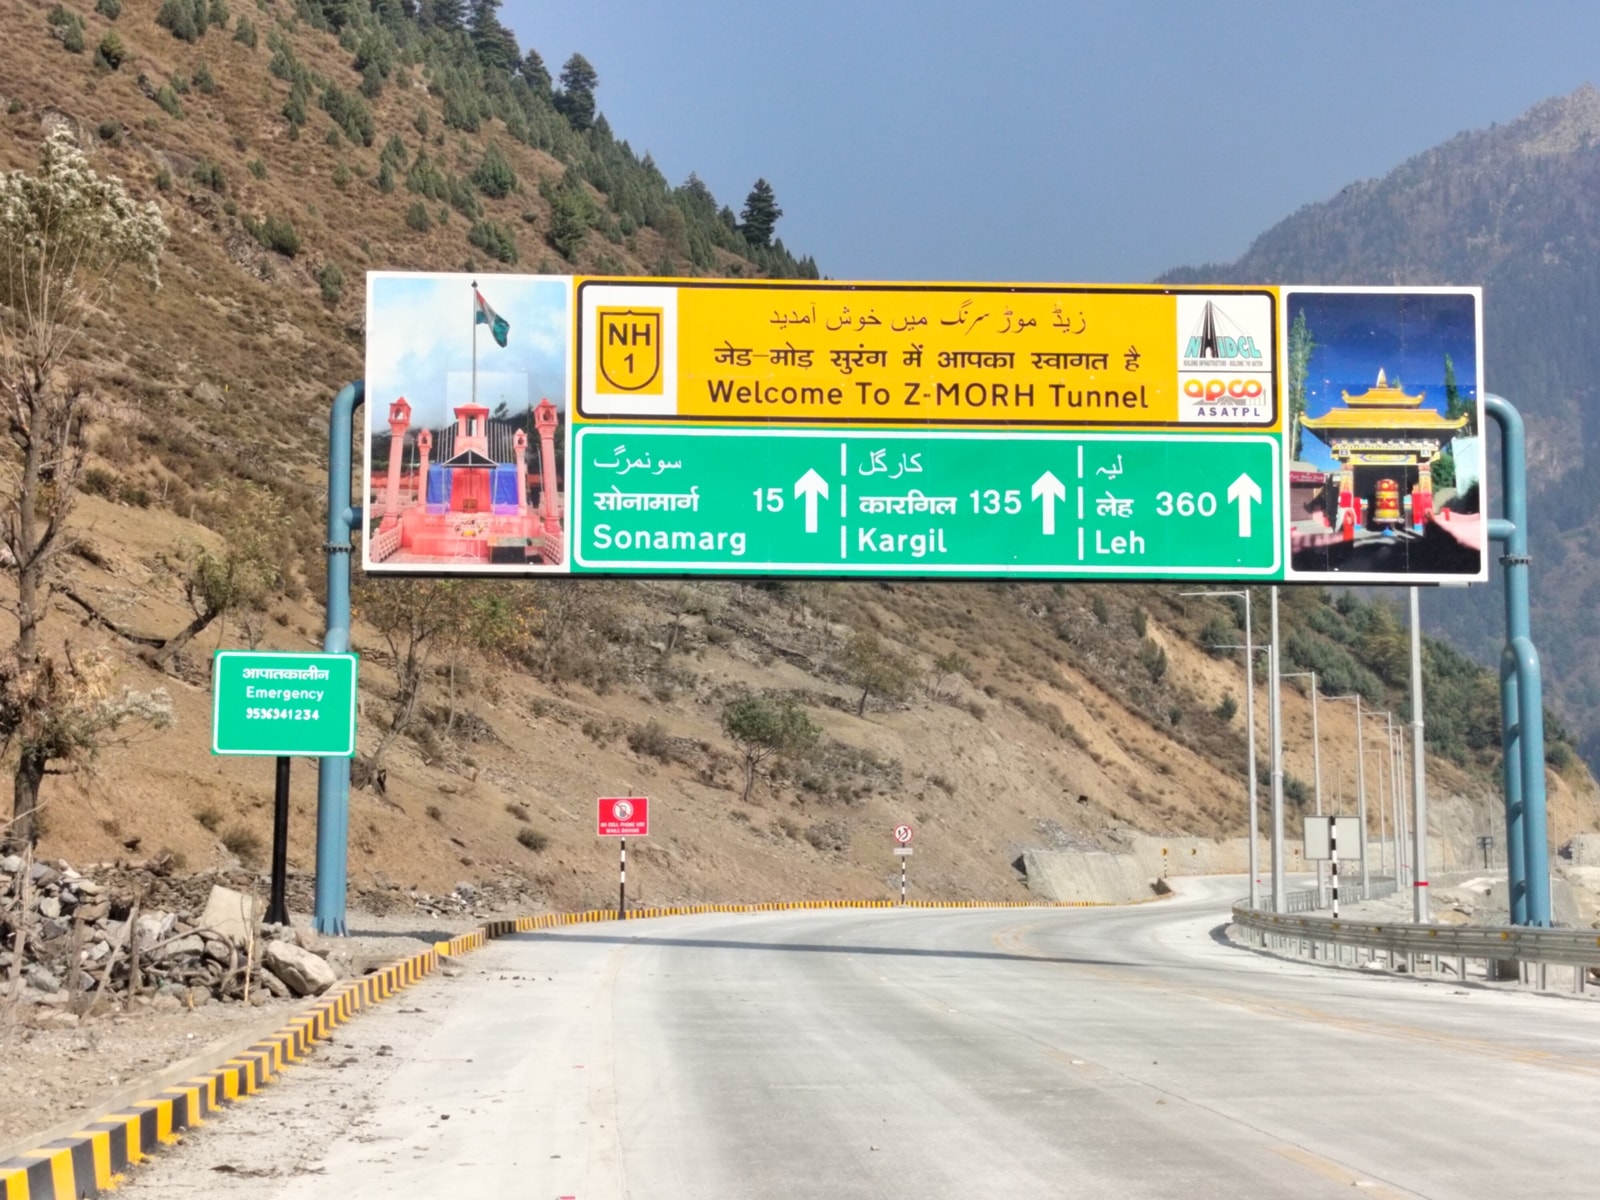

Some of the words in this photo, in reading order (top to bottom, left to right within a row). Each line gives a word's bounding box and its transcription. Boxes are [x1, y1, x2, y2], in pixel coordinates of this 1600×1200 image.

[769, 302, 816, 330] آمدید
[825, 306, 882, 332] خوش
[892, 316, 927, 331] میں
[940, 299, 990, 335] سرنگ
[996, 306, 1037, 334] موڑ
[609, 323, 650, 346] NH
[623, 353, 635, 374] 1
[830, 344, 887, 374] सुरंग
[903, 343, 923, 367] में
[938, 352, 1015, 369] आपका
[1031, 353, 1109, 370] स्वागत
[1124, 345, 1141, 371] है
[708, 380, 842, 405] Welcome
[855, 382, 890, 405] To
[904, 383, 1033, 407] Z-MORH
[1049, 384, 1148, 408] Tunnel
[1197, 407, 1260, 417] ASATPL
[859, 448, 923, 479] کارگل
[594, 486, 699, 511] सोनामार्ग
[754, 488, 783, 512] 15
[860, 490, 957, 514] कारगिल
[970, 490, 1021, 514] 135
[1096, 491, 1134, 517] लेह
[1157, 492, 1216, 516] 360
[593, 524, 745, 555] Sonamarg
[859, 528, 947, 557] Kargil
[1096, 530, 1144, 554] Leh
[242, 664, 330, 680] आपातकालीन
[246, 685, 324, 702] Emergency
